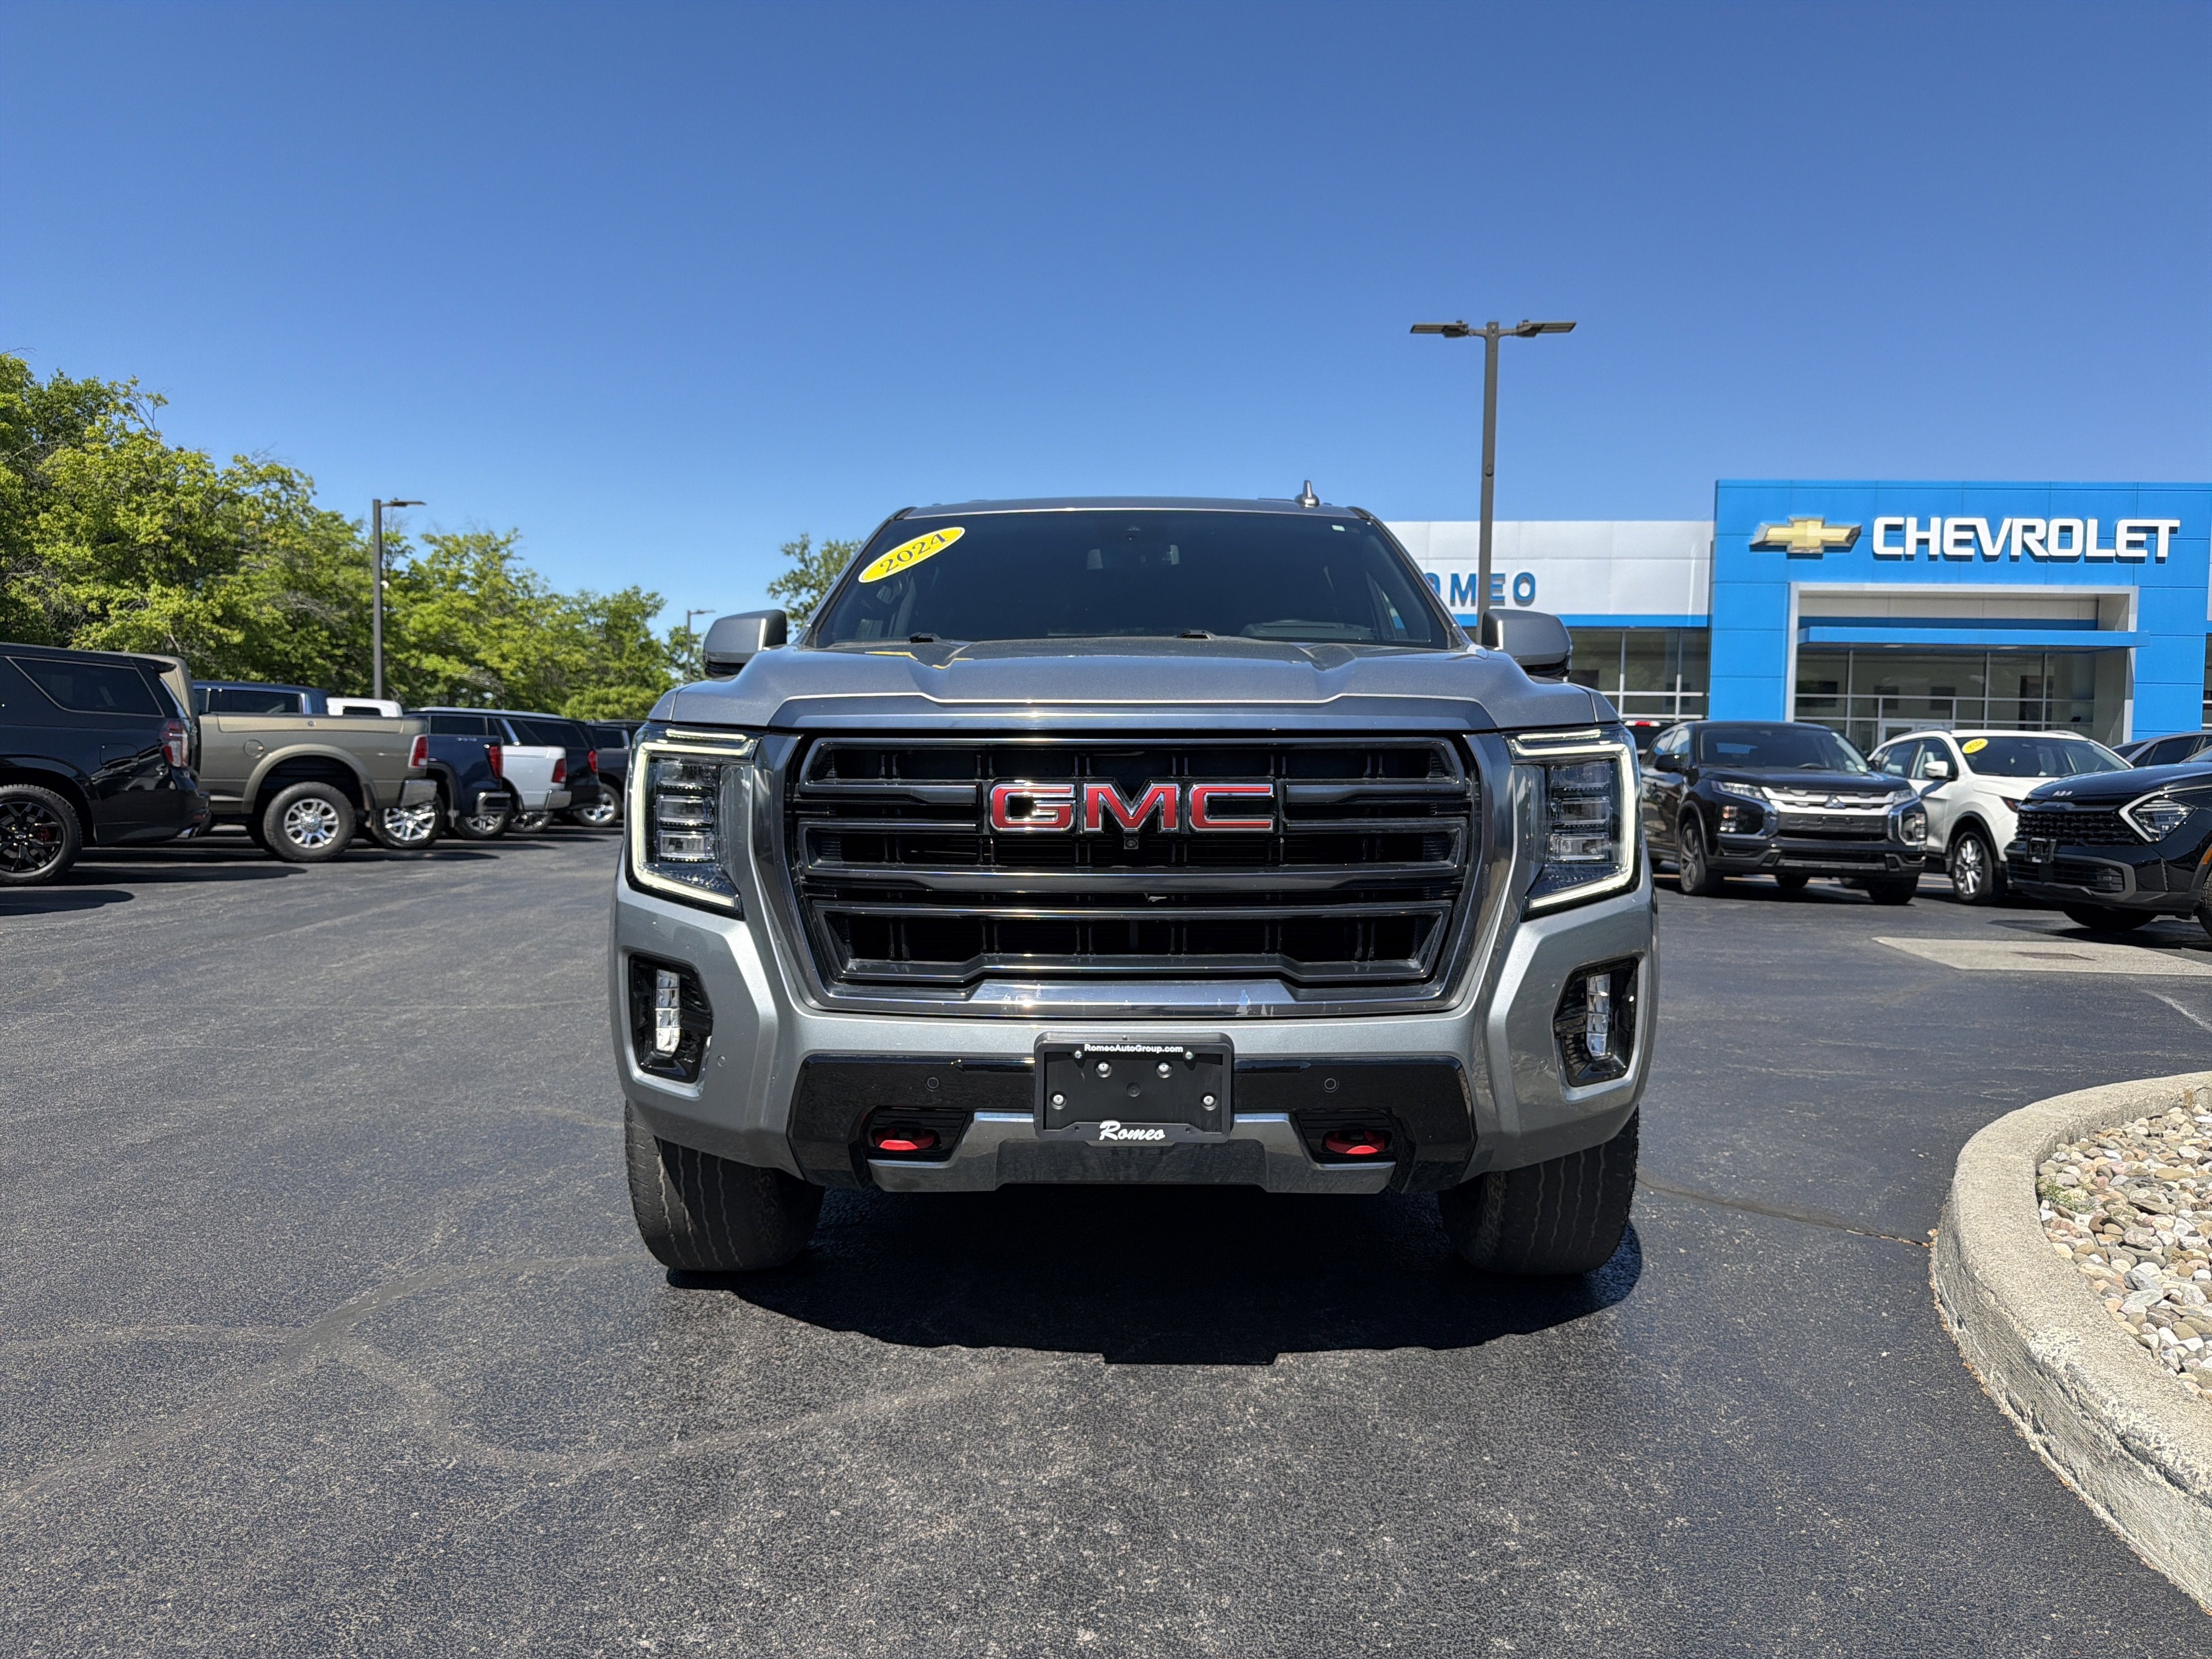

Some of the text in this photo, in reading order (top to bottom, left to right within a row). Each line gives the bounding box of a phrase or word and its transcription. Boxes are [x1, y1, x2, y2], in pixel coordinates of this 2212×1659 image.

[879, 533, 949, 573] 2024
[1872, 517, 2181, 558] CHEVROLET
[989, 781, 1275, 833] GMC
[1084, 1043, 1183, 1054] RomeoAutoGroup.com
[1099, 1120, 1166, 1141] Romeo
